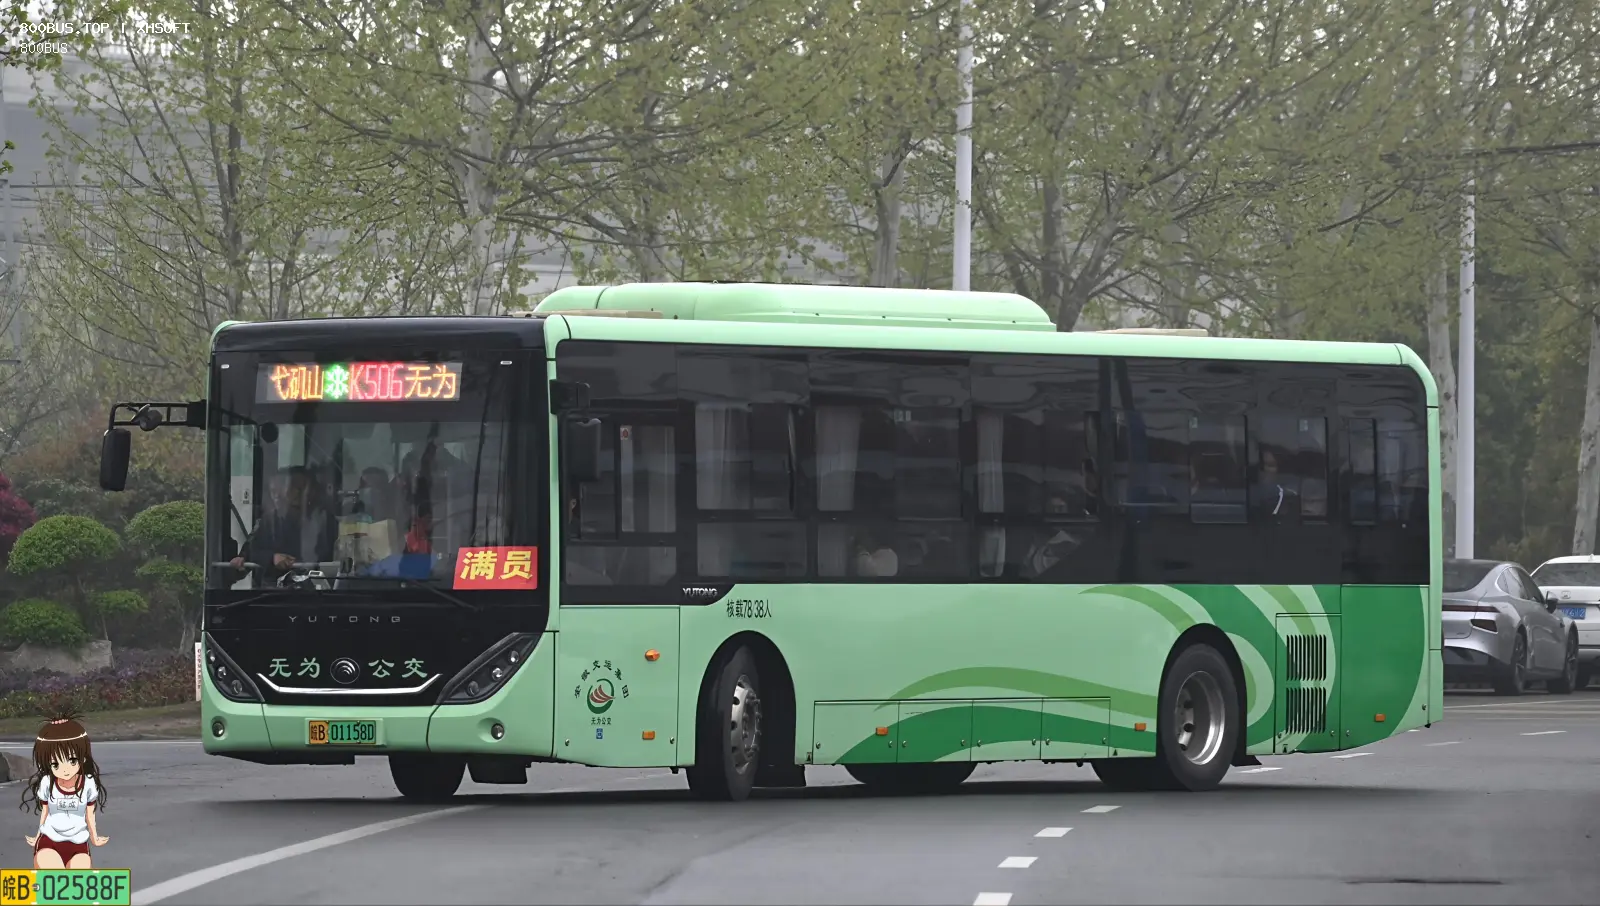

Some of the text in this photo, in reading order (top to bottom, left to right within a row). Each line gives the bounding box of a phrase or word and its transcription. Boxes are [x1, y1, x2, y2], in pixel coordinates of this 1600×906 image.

[350, 363, 404, 400] K506
[404, 364, 457, 400] 无为
[460, 550, 533, 580] 满员
[682, 586, 718, 598] YUTONG
[288, 615, 401, 623] YUTONG
[268, 657, 428, 679] 无为 公交
